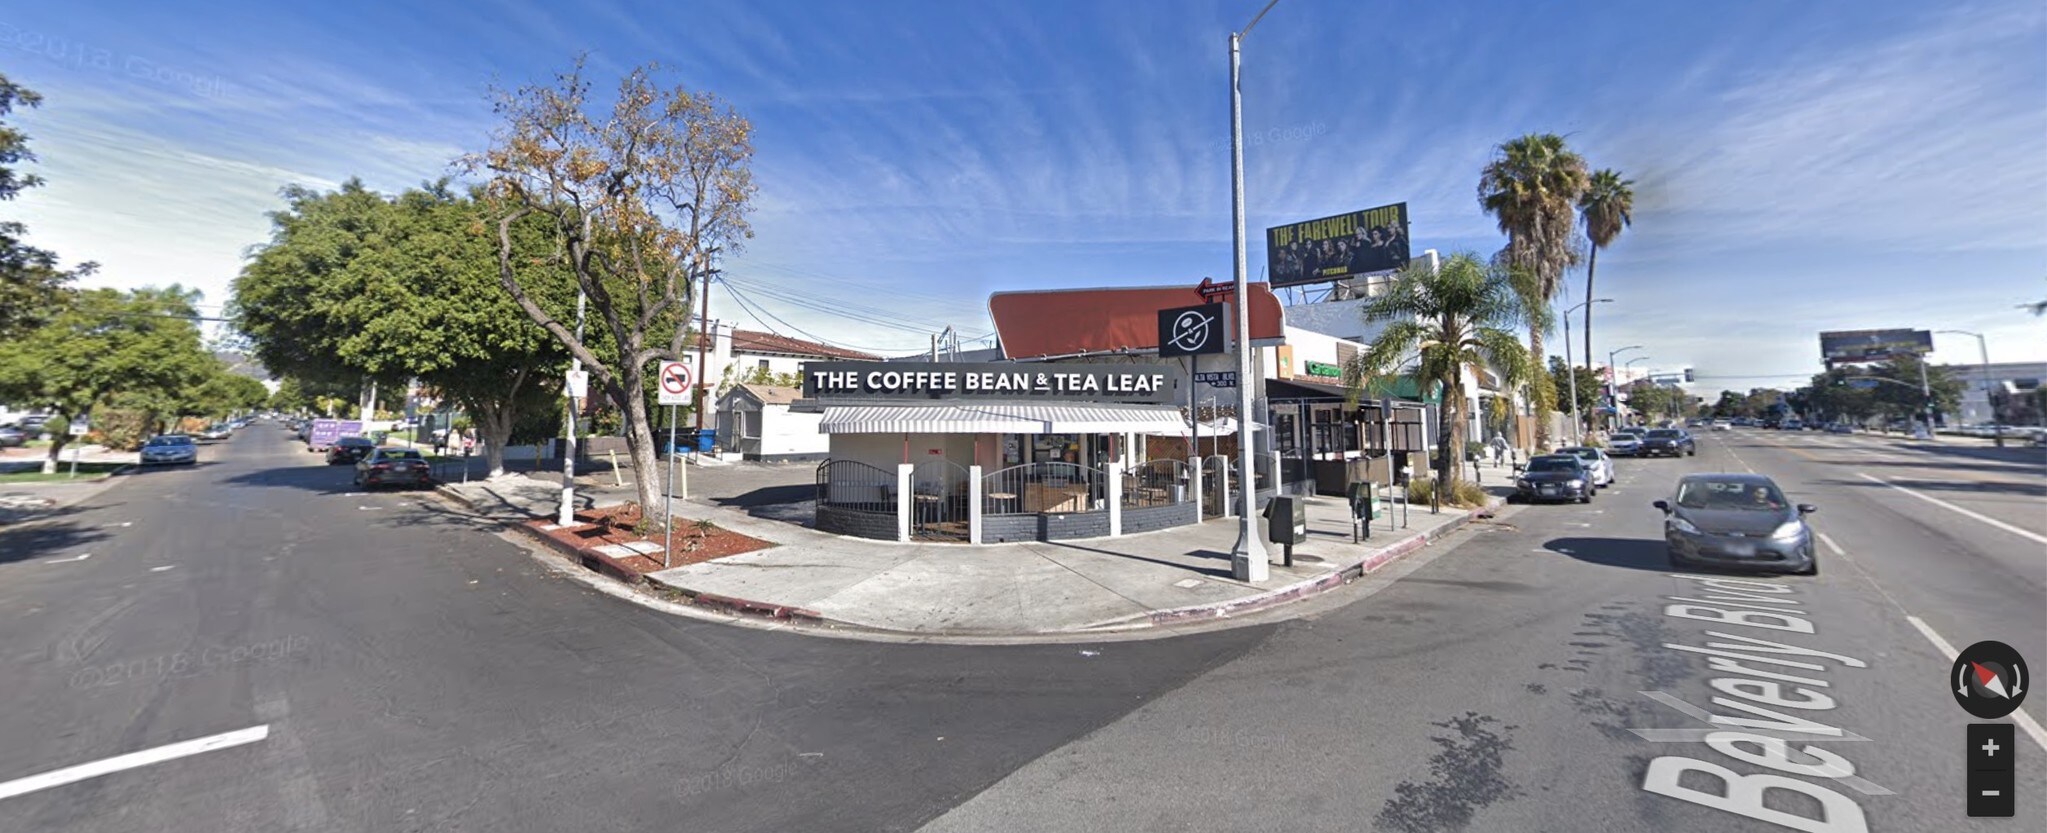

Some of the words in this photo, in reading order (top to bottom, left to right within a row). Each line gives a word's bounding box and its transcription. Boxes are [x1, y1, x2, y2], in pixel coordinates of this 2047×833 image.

[1272, 225, 1295, 247] THE
[1297, 213, 1358, 243] FAREWELL
[1362, 205, 1399, 230] TOUR
[813, 371, 859, 389] THE
[866, 371, 957, 390] COFFEE
[965, 372, 1029, 391] BEAN
[1035, 373, 1051, 391] &
[1054, 373, 1100, 392] TEA
[1106, 373, 1164, 392] LEAF
[1194, 373, 1206, 381] ALTA
[1206, 373, 1219, 381] VISTA
